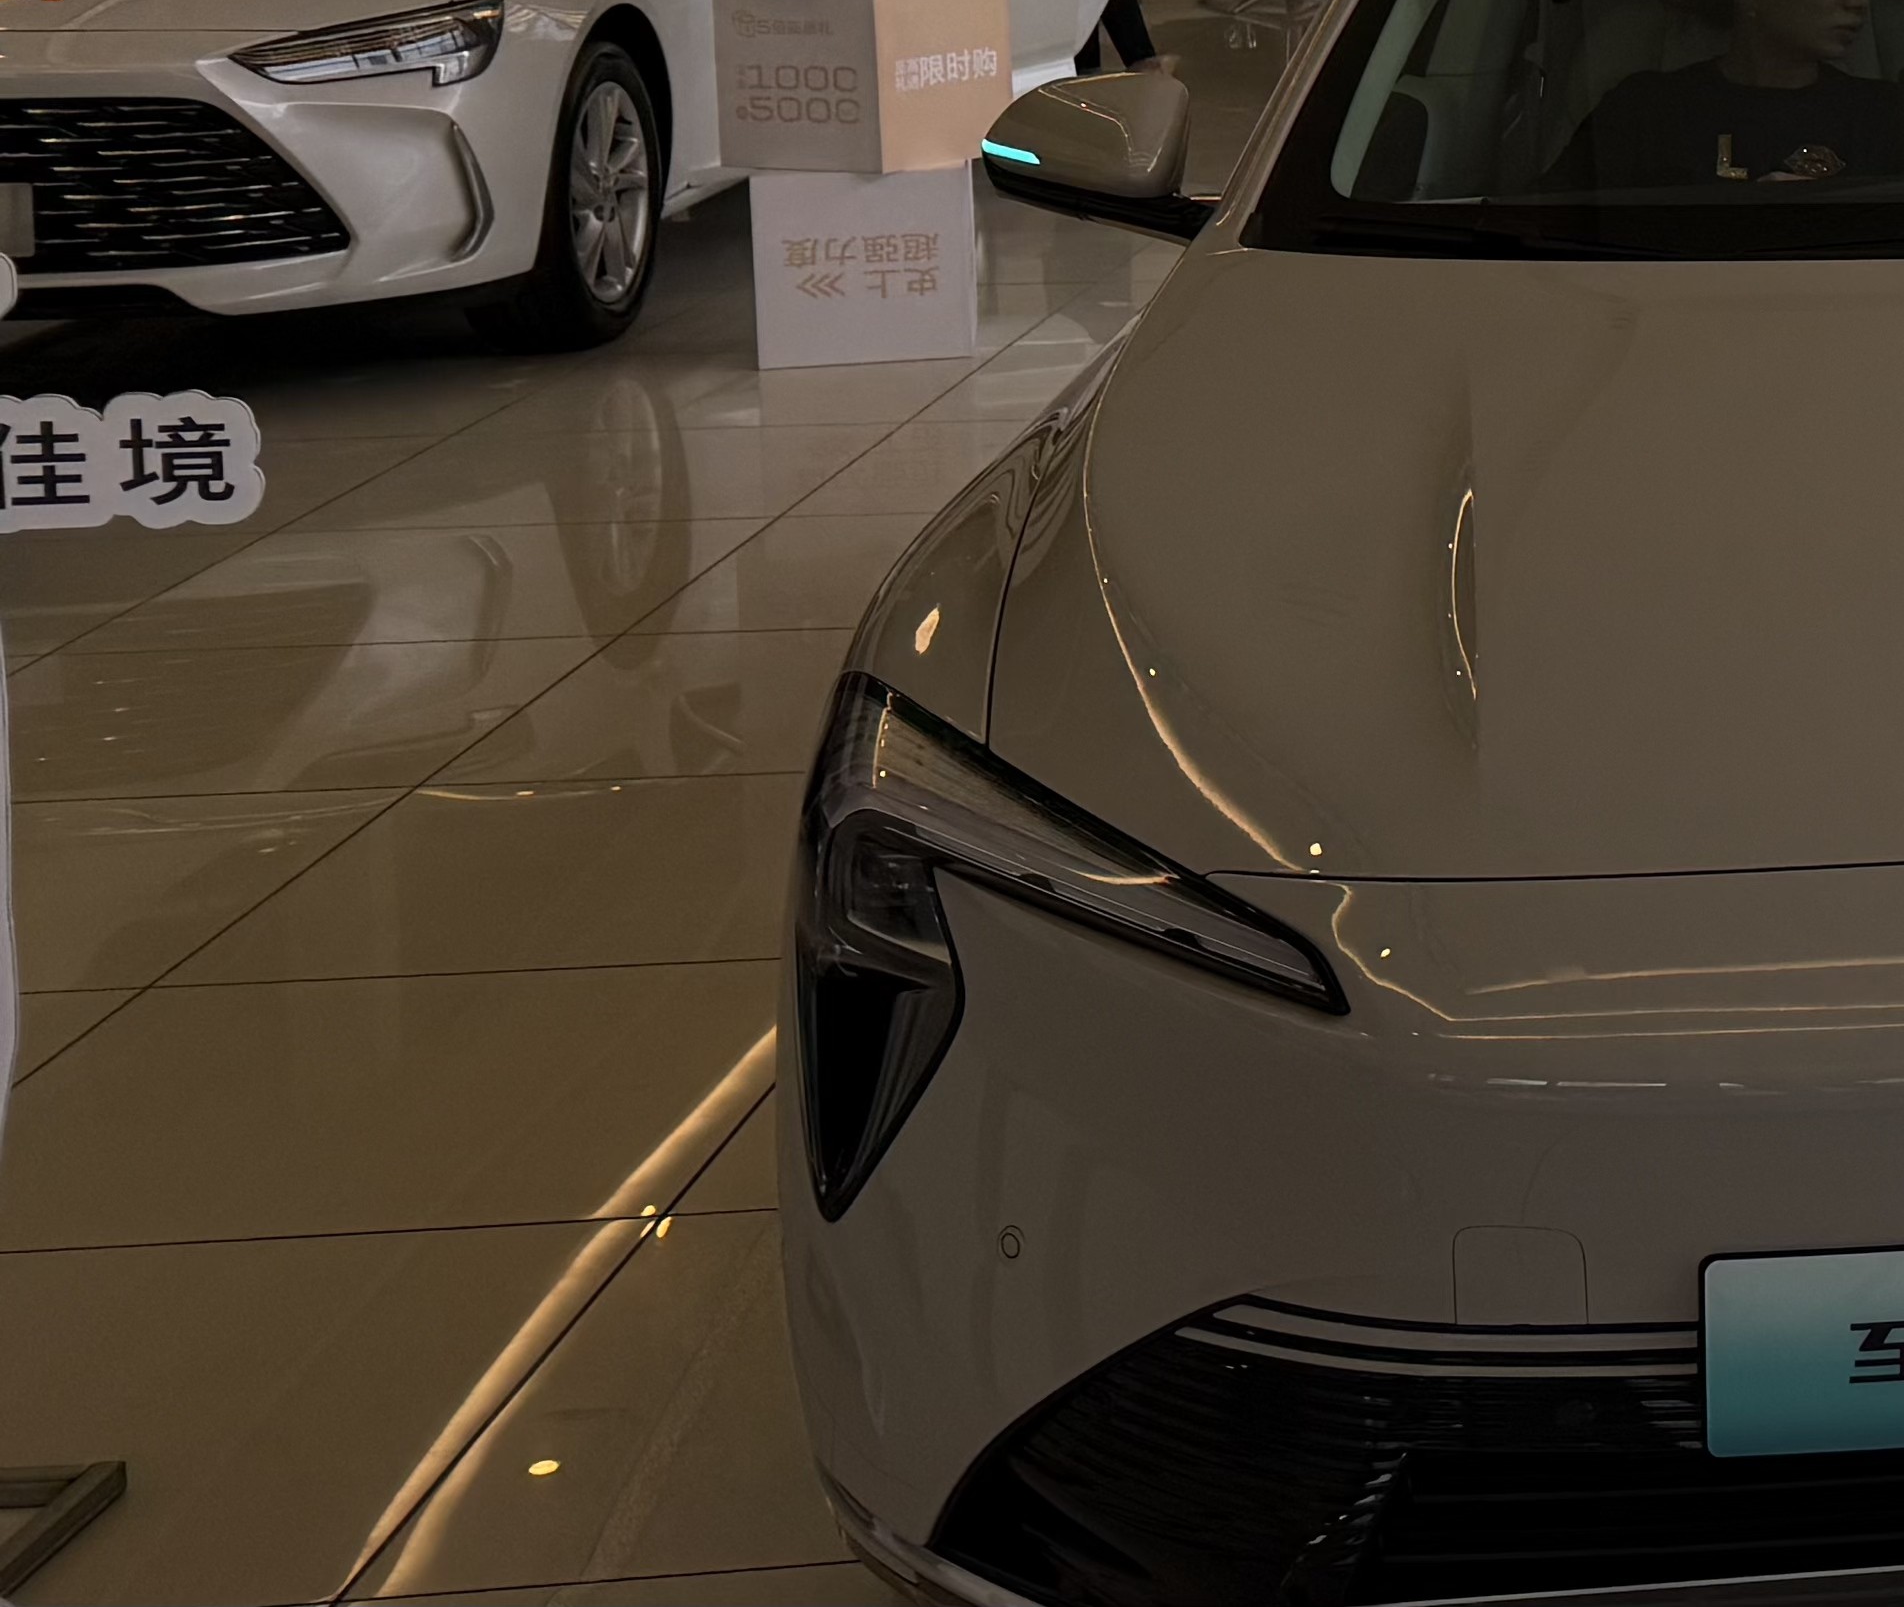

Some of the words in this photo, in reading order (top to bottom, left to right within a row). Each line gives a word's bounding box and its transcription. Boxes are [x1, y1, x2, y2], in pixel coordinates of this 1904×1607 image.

[920, 46, 998, 89] 限时购
[781, 232, 940, 270] 超强力度
[862, 265, 940, 300] 史上
[0, 416, 236, 510] 佳境
